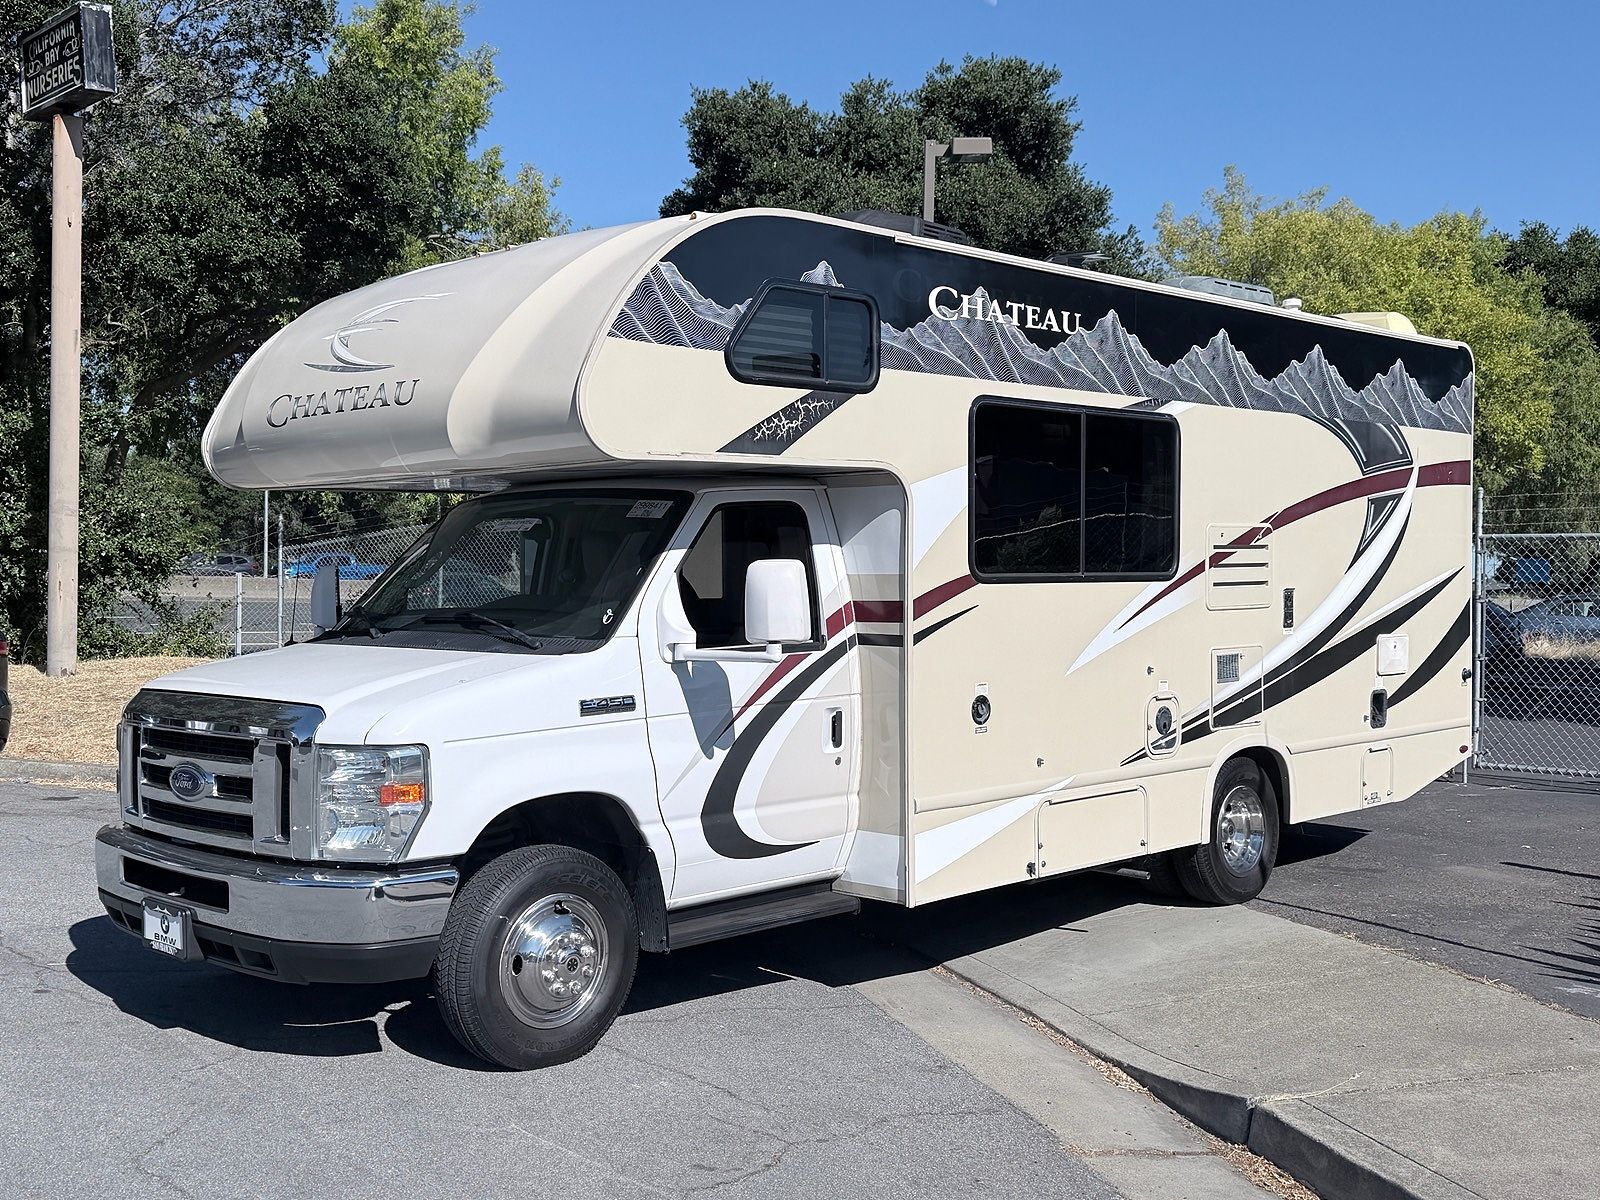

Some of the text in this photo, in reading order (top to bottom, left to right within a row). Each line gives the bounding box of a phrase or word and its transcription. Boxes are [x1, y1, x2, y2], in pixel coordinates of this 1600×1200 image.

[28, 20, 76, 60] CALIFORNIA
[44, 45, 60, 67] BAY
[26, 55, 82, 108] NURSERIES
[928, 285, 1081, 335] CHATEAU
[266, 379, 420, 428] CHATEAU
[175, 772, 193, 789] Ford
[154, 933, 177, 946] BMW
